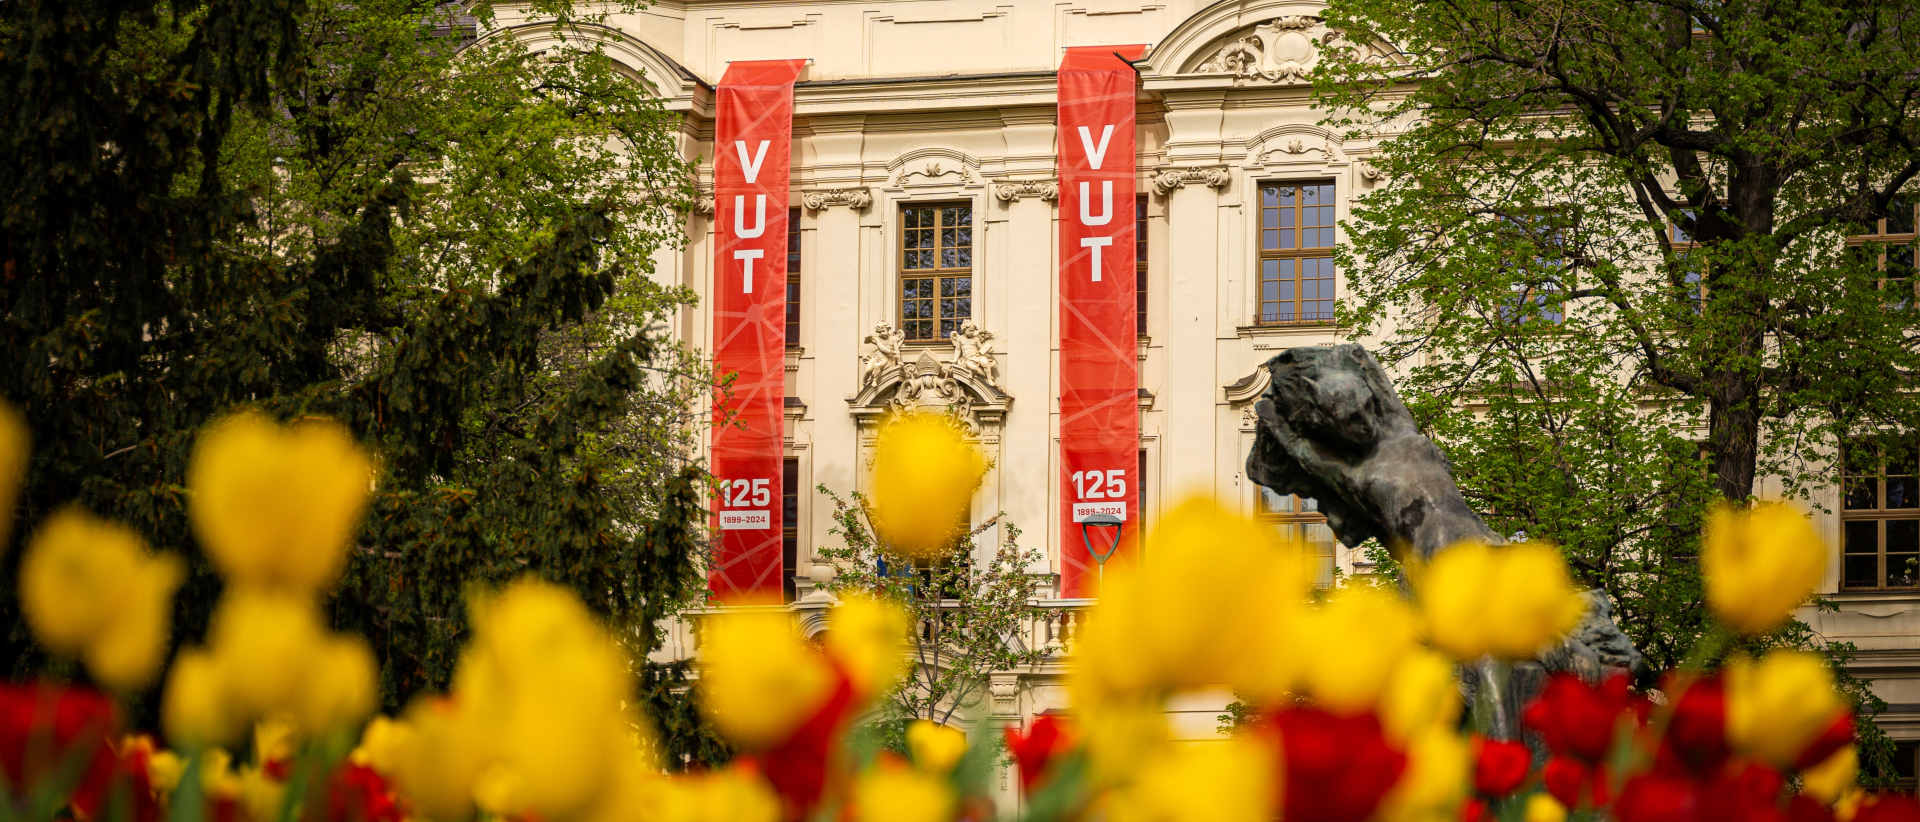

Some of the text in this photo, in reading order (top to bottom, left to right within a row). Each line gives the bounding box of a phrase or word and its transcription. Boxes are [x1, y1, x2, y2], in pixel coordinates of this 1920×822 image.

[733, 140, 771, 294] VUT
[1077, 124, 1115, 282] VUT
[720, 478, 770, 507] 125
[1072, 469, 1126, 499] 125
